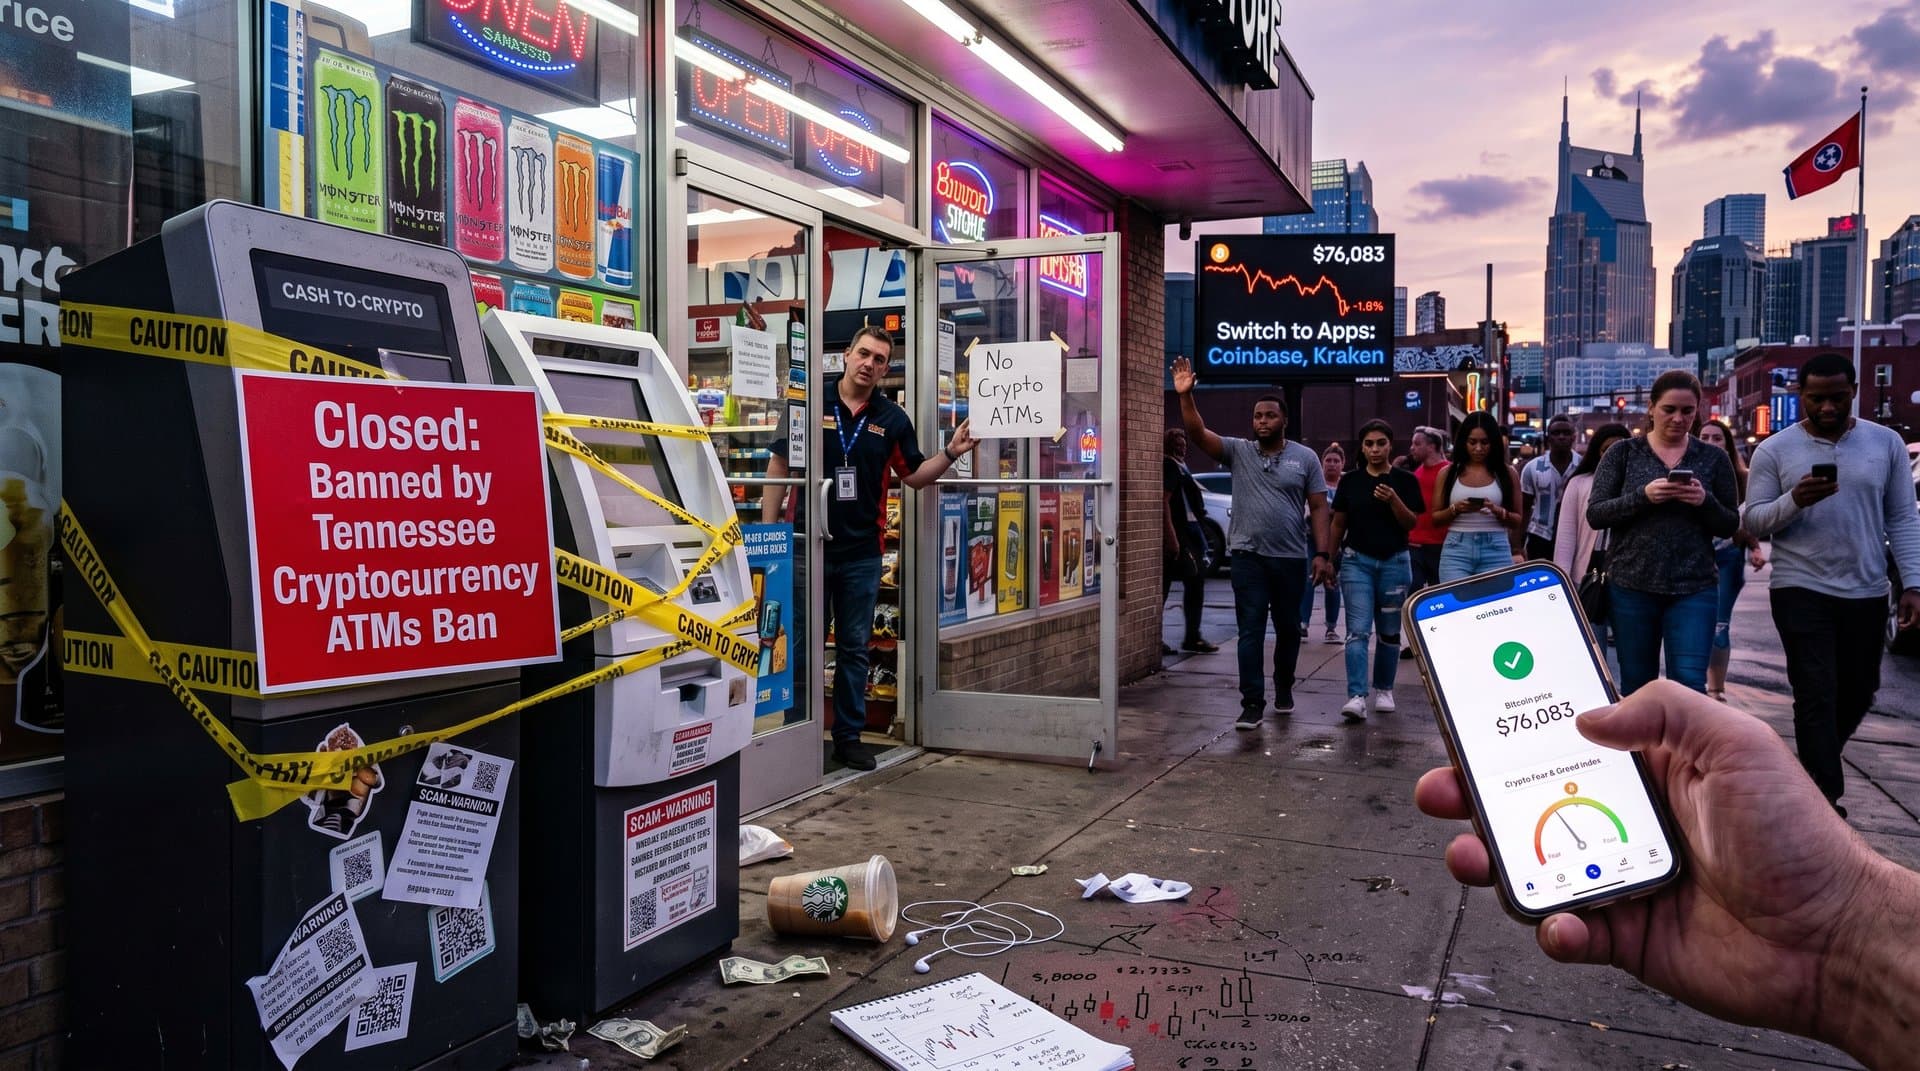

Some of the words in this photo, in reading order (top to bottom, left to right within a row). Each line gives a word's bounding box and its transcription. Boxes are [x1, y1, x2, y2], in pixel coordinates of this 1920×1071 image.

[389, 200, 445, 223] MONSTER
[1313, 244, 1385, 265] $76,083
[282, 282, 330, 304] CASH
[130, 317, 229, 357] CAUTION
[1217, 321, 1284, 340] Switch
[1291, 322, 1313, 340] to
[1317, 322, 1376, 344] Apps:
[987, 350, 1013, 371] No
[1208, 346, 1308, 368] Coinbase,
[1314, 346, 1385, 365] Kraken
[978, 375, 1043, 404] Crypto
[314, 400, 480, 451] Closed:
[990, 405, 1043, 426] ATMs
[308, 462, 443, 500] Banned
[452, 464, 492, 506] by
[312, 513, 496, 551] Tennessee
[61, 514, 116, 606] CAUTION
[273, 562, 539, 611] Cryptocurrency
[557, 556, 633, 606] CAUTION
[678, 613, 712, 645] CASH
[716, 632, 730, 655] TO
[1476, 606, 1513, 620] coinbase
[326, 611, 421, 653] ATMs
[433, 607, 497, 644] Ban
[1505, 697, 1533, 710] Bitcoin
[1535, 692, 1553, 703] price
[1496, 701, 1575, 737] $76,083
[1505, 777, 1531, 788] Crypto
[1532, 772, 1548, 781] Fear
[1556, 763, 1580, 774] Greed
[630, 791, 711, 833] SCAM-WARNING
[291, 900, 344, 943] WARNING
